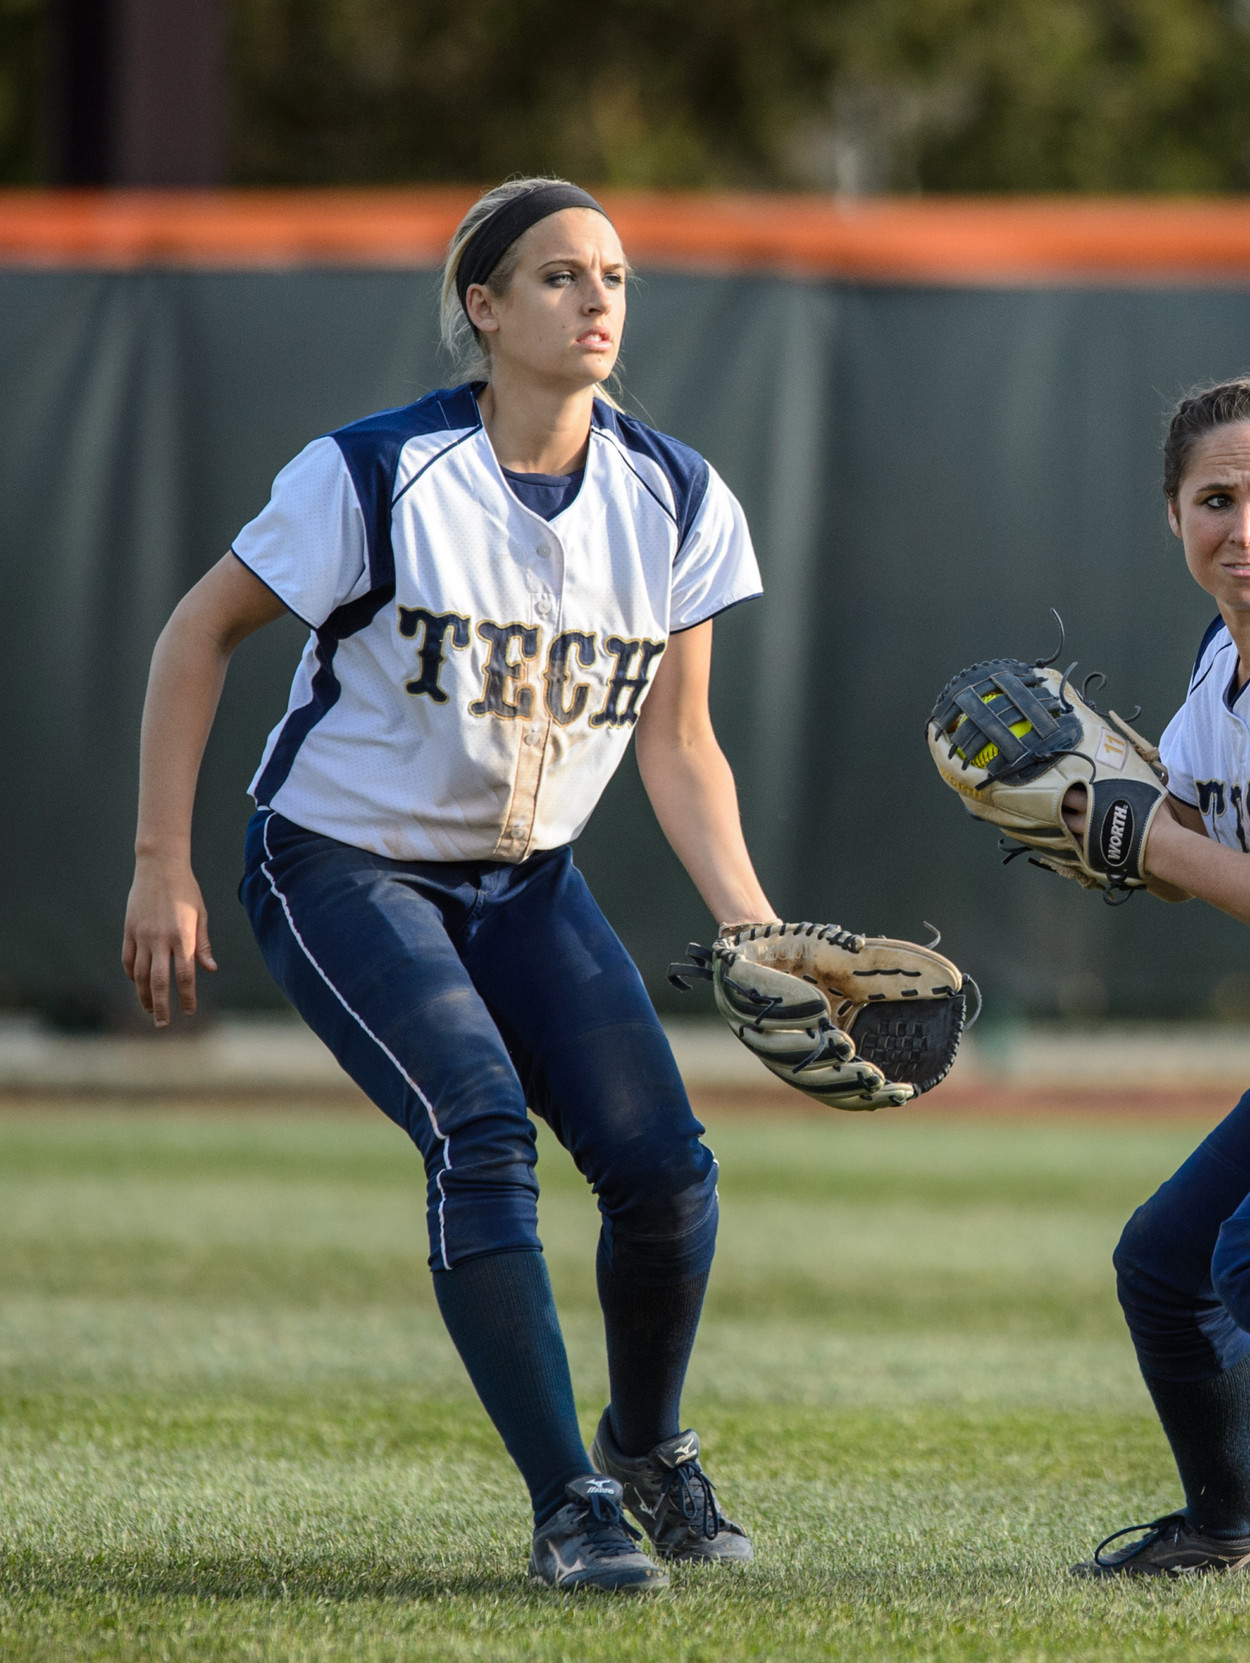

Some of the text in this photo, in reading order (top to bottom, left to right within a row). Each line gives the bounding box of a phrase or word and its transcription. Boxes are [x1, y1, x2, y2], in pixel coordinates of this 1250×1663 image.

[398, 605, 667, 728] TECH
[1104, 734, 1125, 754] 11
[1108, 805, 1128, 860] WORTH
